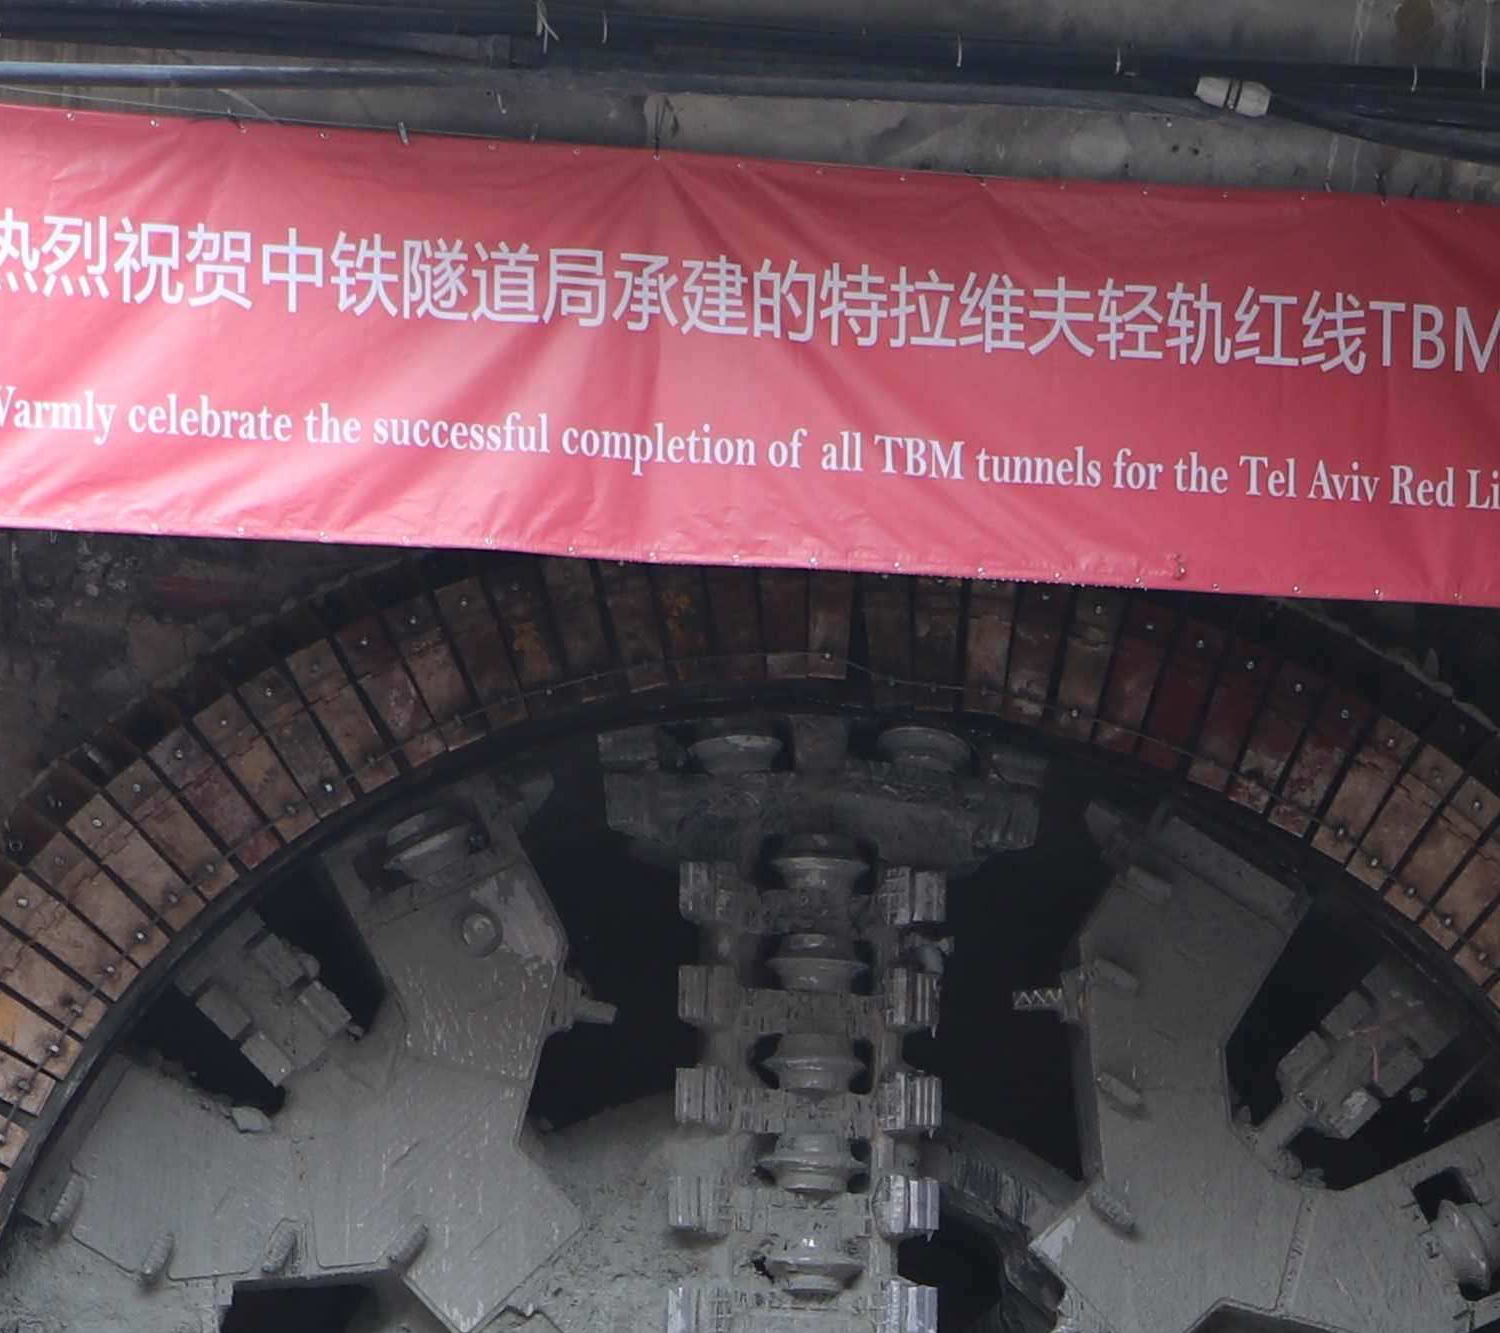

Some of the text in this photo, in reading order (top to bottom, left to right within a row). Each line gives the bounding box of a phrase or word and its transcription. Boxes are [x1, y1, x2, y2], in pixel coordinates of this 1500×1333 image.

[127, 396, 293, 442] celebrate
[305, 404, 362, 446] the
[373, 411, 551, 456] successful
[562, 423, 757, 476] completion
[768, 428, 809, 469] of
[821, 431, 865, 472] all
[875, 435, 965, 481] TBM
[977, 444, 1103, 487] tunnels
[1114, 449, 1164, 490] for
[1176, 453, 1229, 495] the
[1240, 456, 1297, 499] Tel
[1309, 461, 1379, 503] Aviv
[1392, 466, 1455, 508] Red
